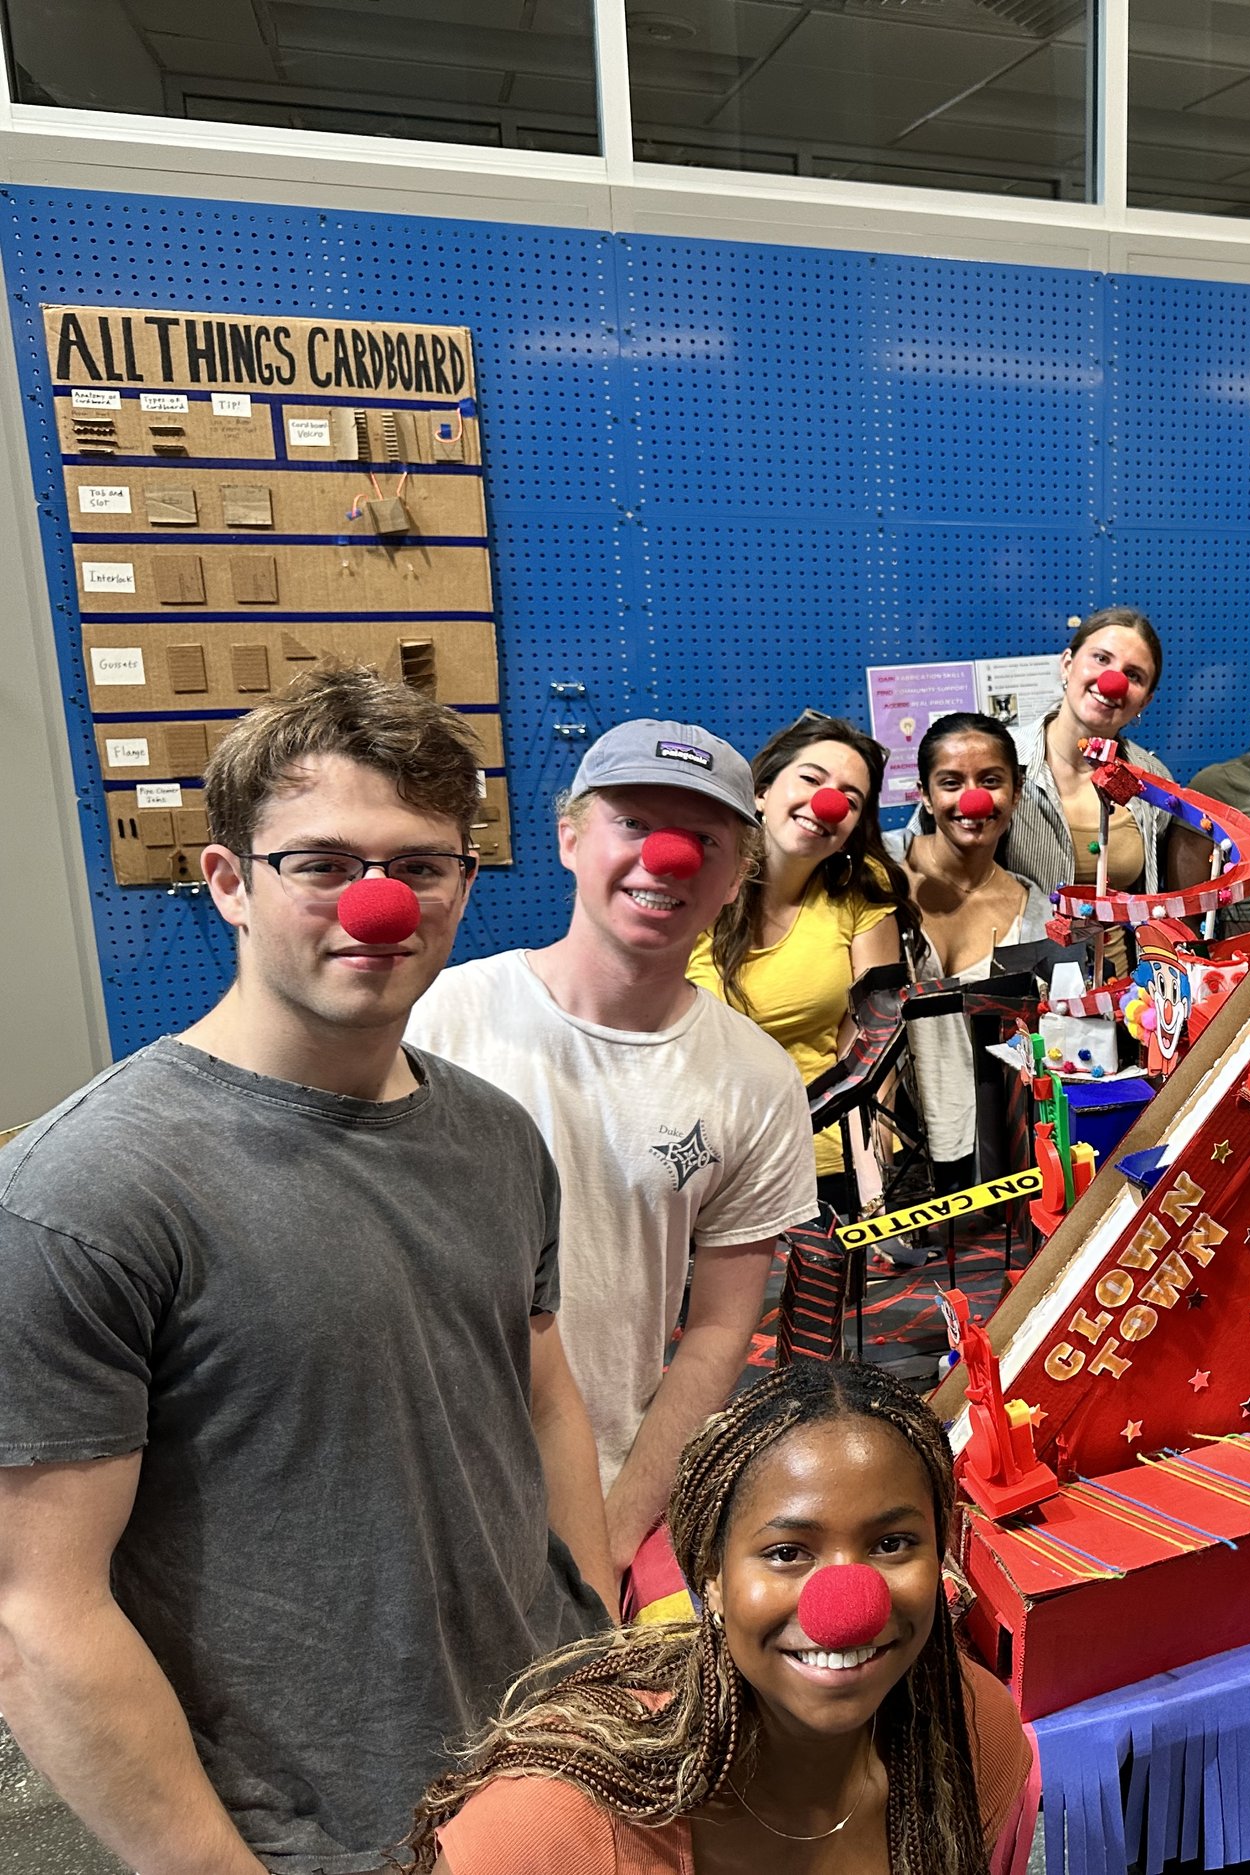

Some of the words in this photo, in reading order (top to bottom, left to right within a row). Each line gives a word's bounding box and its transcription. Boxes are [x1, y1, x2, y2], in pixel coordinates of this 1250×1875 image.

[56, 313, 144, 383] ALL
[144, 316, 297, 387] THINGS
[307, 327, 466, 396] CARDBOARD
[89, 489, 107, 497] Tab
[88, 570, 133, 584] Interlock
[113, 746, 147, 760] Flange
[659, 1124, 685, 1138] Duke
[1044, 1170, 1207, 1381] CLOWN
[1087, 1212, 1230, 1380] TOWN
